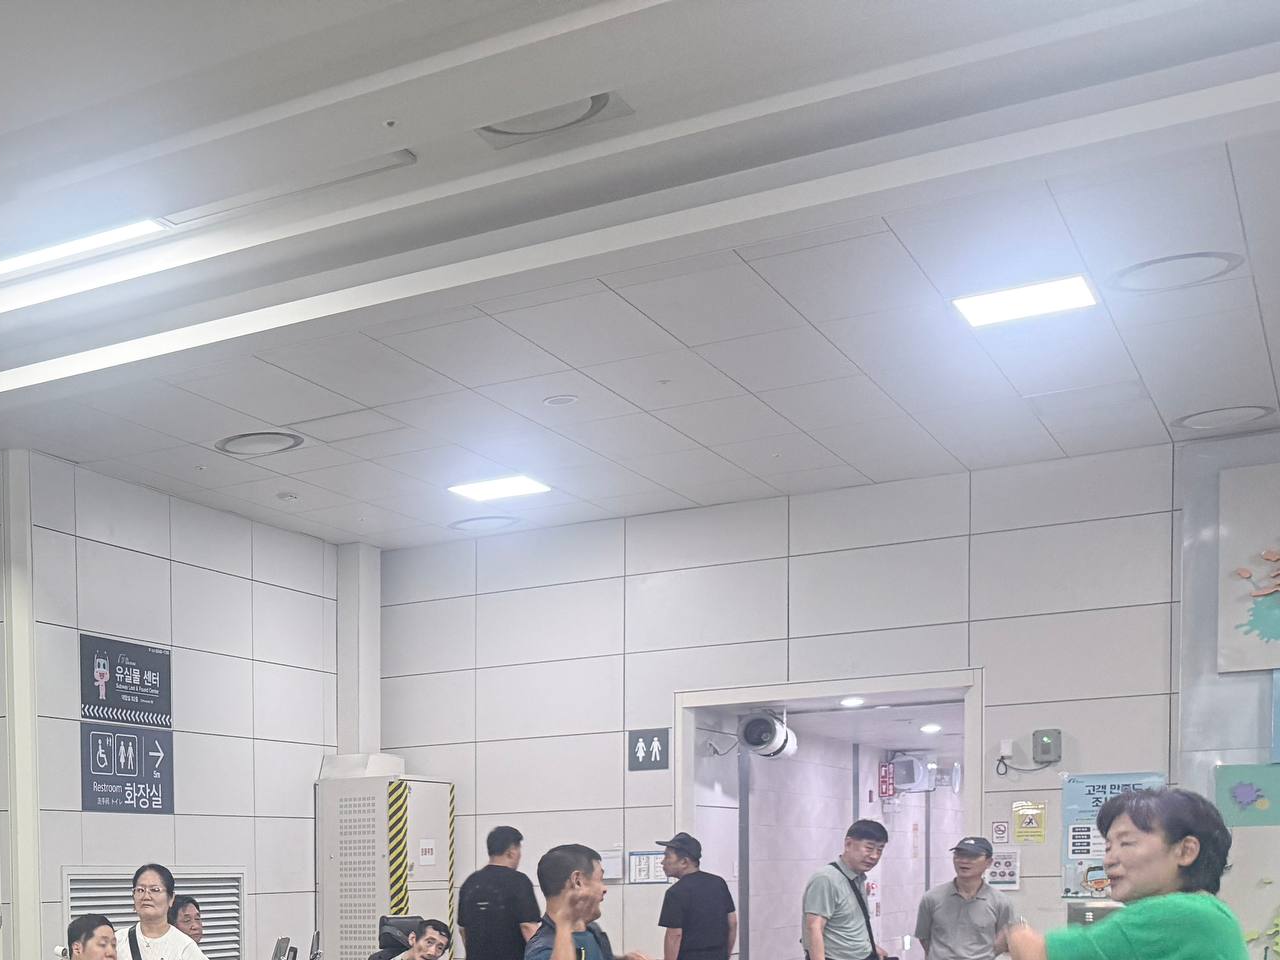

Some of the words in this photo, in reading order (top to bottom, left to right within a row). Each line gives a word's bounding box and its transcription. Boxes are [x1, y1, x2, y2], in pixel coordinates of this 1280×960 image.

[115, 665, 141, 685] 유실물
[143, 670, 160, 688] 센터
[93, 781, 123, 793] Restroom
[124, 782, 162, 808] 화장실
[1085, 784, 1107, 796] 고객
